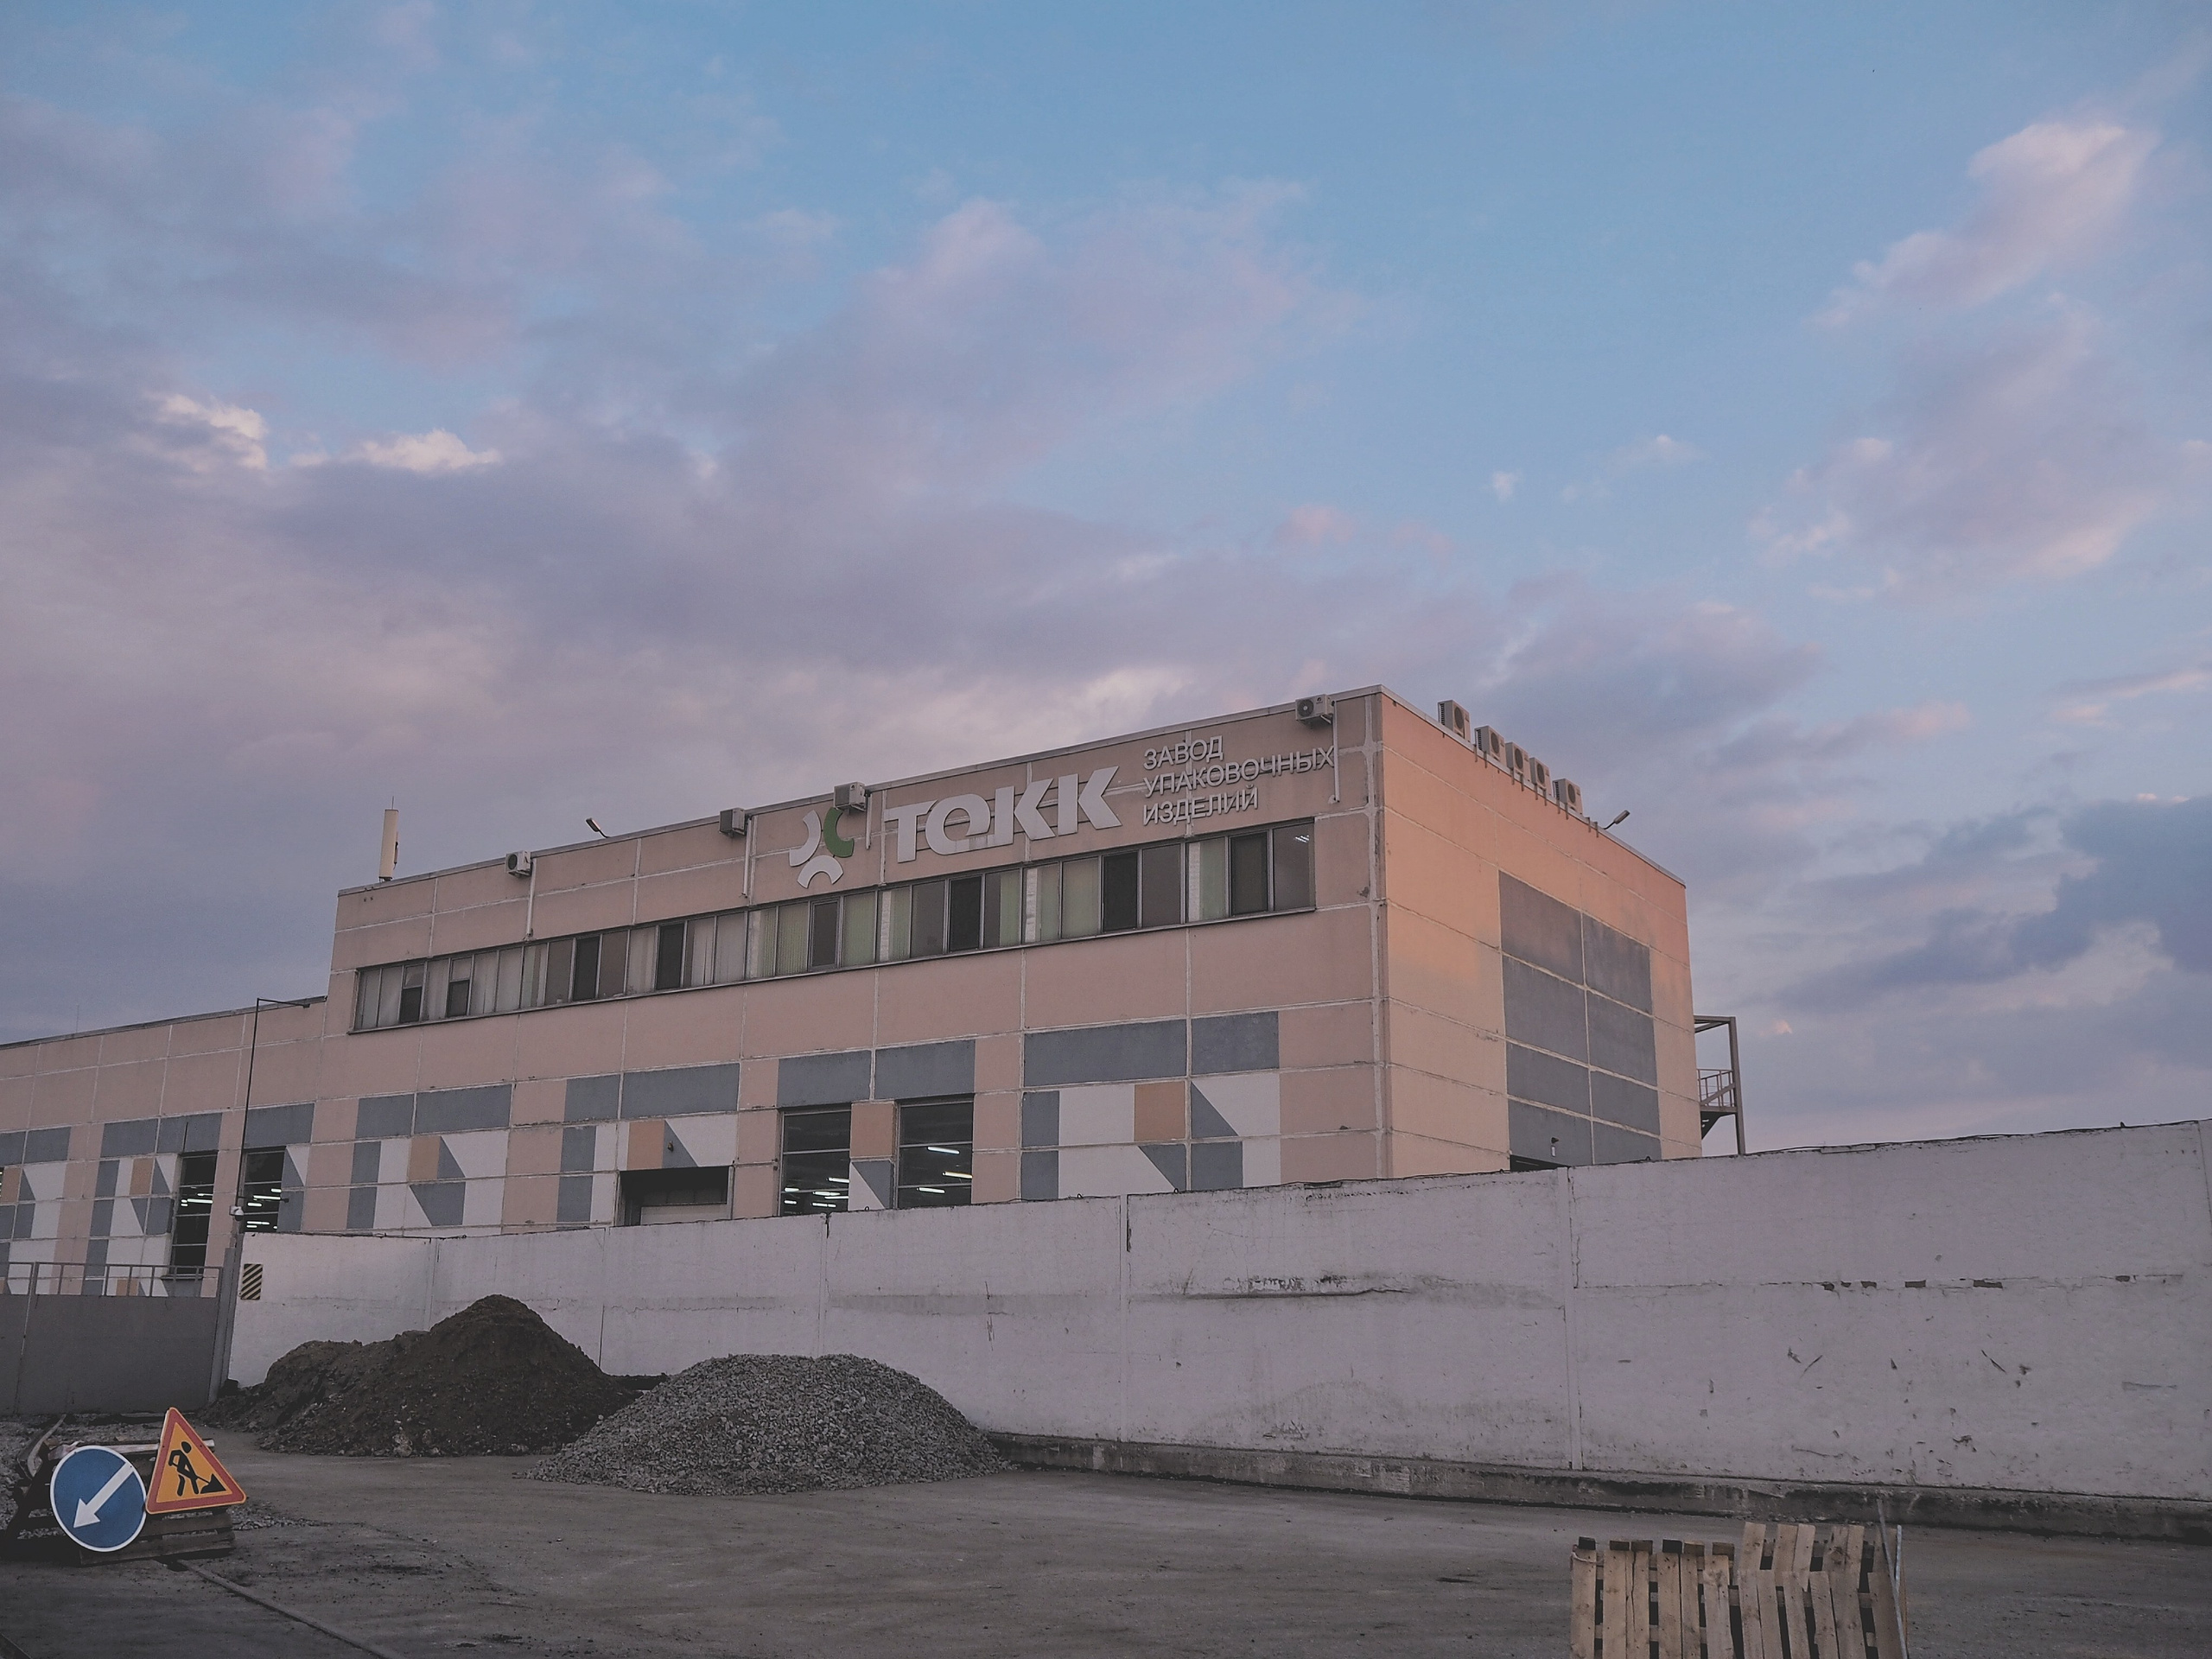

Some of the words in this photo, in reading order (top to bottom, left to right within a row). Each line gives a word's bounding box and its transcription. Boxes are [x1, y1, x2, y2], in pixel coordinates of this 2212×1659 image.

[1143, 735, 1224, 770] ЗАВОД
[1143, 746, 1334, 798] УПАКОВОЧНЫХ
[1143, 784, 1258, 826] ИЗДЕЛИЙ
